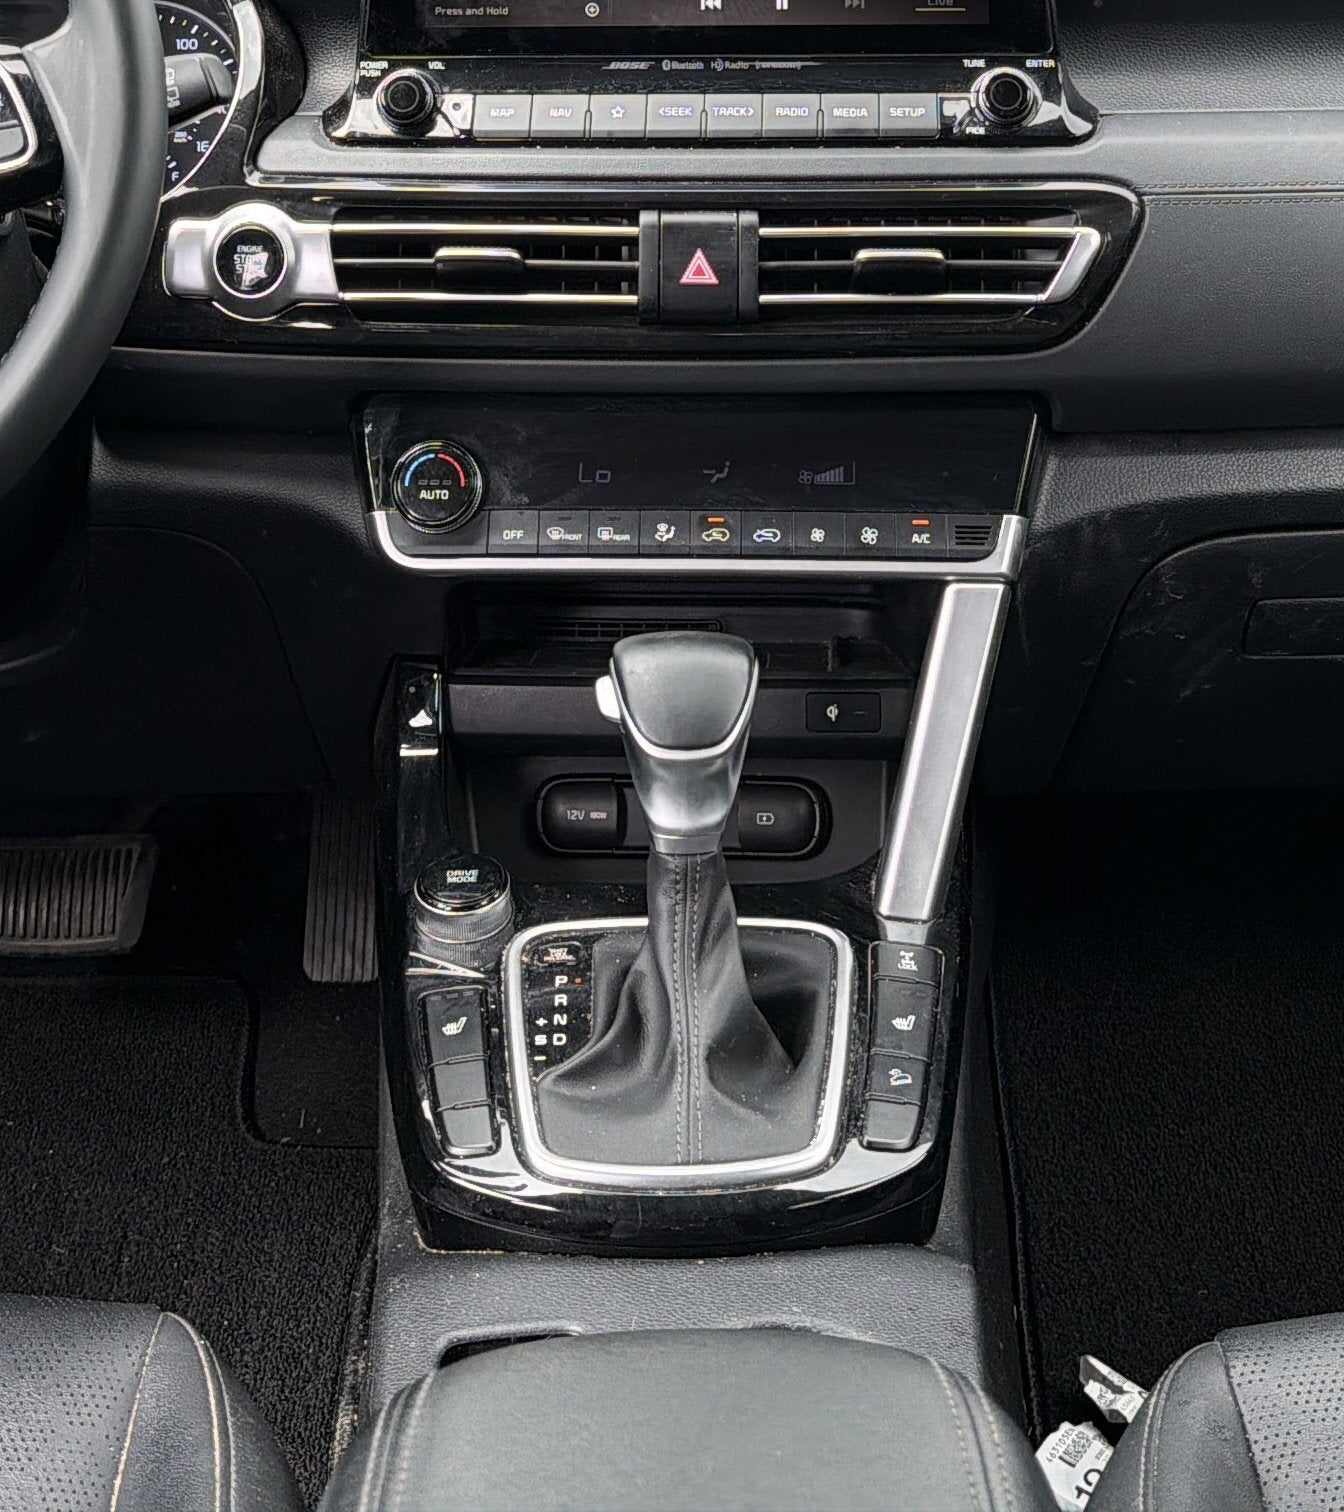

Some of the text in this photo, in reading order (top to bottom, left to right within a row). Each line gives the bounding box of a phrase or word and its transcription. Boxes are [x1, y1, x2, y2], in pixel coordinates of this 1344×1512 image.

[434, 6, 509, 15] Press and Hold
[175, 38, 199, 51] 100
[359, 61, 389, 69] POWER
[427, 61, 445, 70] VOL
[602, 61, 655, 70] BOSE
[671, 60, 705, 70] Bluetooth
[725, 60, 749, 70] Radio
[962, 59, 986, 68] TUNE
[1025, 59, 1055, 68] ENTER
[359, 69, 382, 77] PUSH
[490, 108, 515, 117] MAP
[549, 108, 572, 117] NAV
[775, 106, 809, 117] RADIO
[832, 107, 868, 117] MEDIA
[889, 107, 926, 117] SETUP
[965, 126, 986, 135] FILE
[171, 171, 180, 182] F
[236, 245, 264, 253] ENGINE
[578, 462, 612, 484] Lo
[419, 489, 449, 500] AUTO
[502, 529, 524, 539] OFF
[562, 533, 583, 541] FRONT
[911, 533, 931, 544] A/C
[566, 809, 585, 820] 12V
[446, 868, 479, 877] DRIVE
[446, 876, 478, 884] MODE
[555, 975, 568, 988] P
[554, 994, 568, 1006] R
[553, 1013, 568, 1026] N
[534, 1034, 548, 1046] S
[552, 1033, 567, 1045] D
